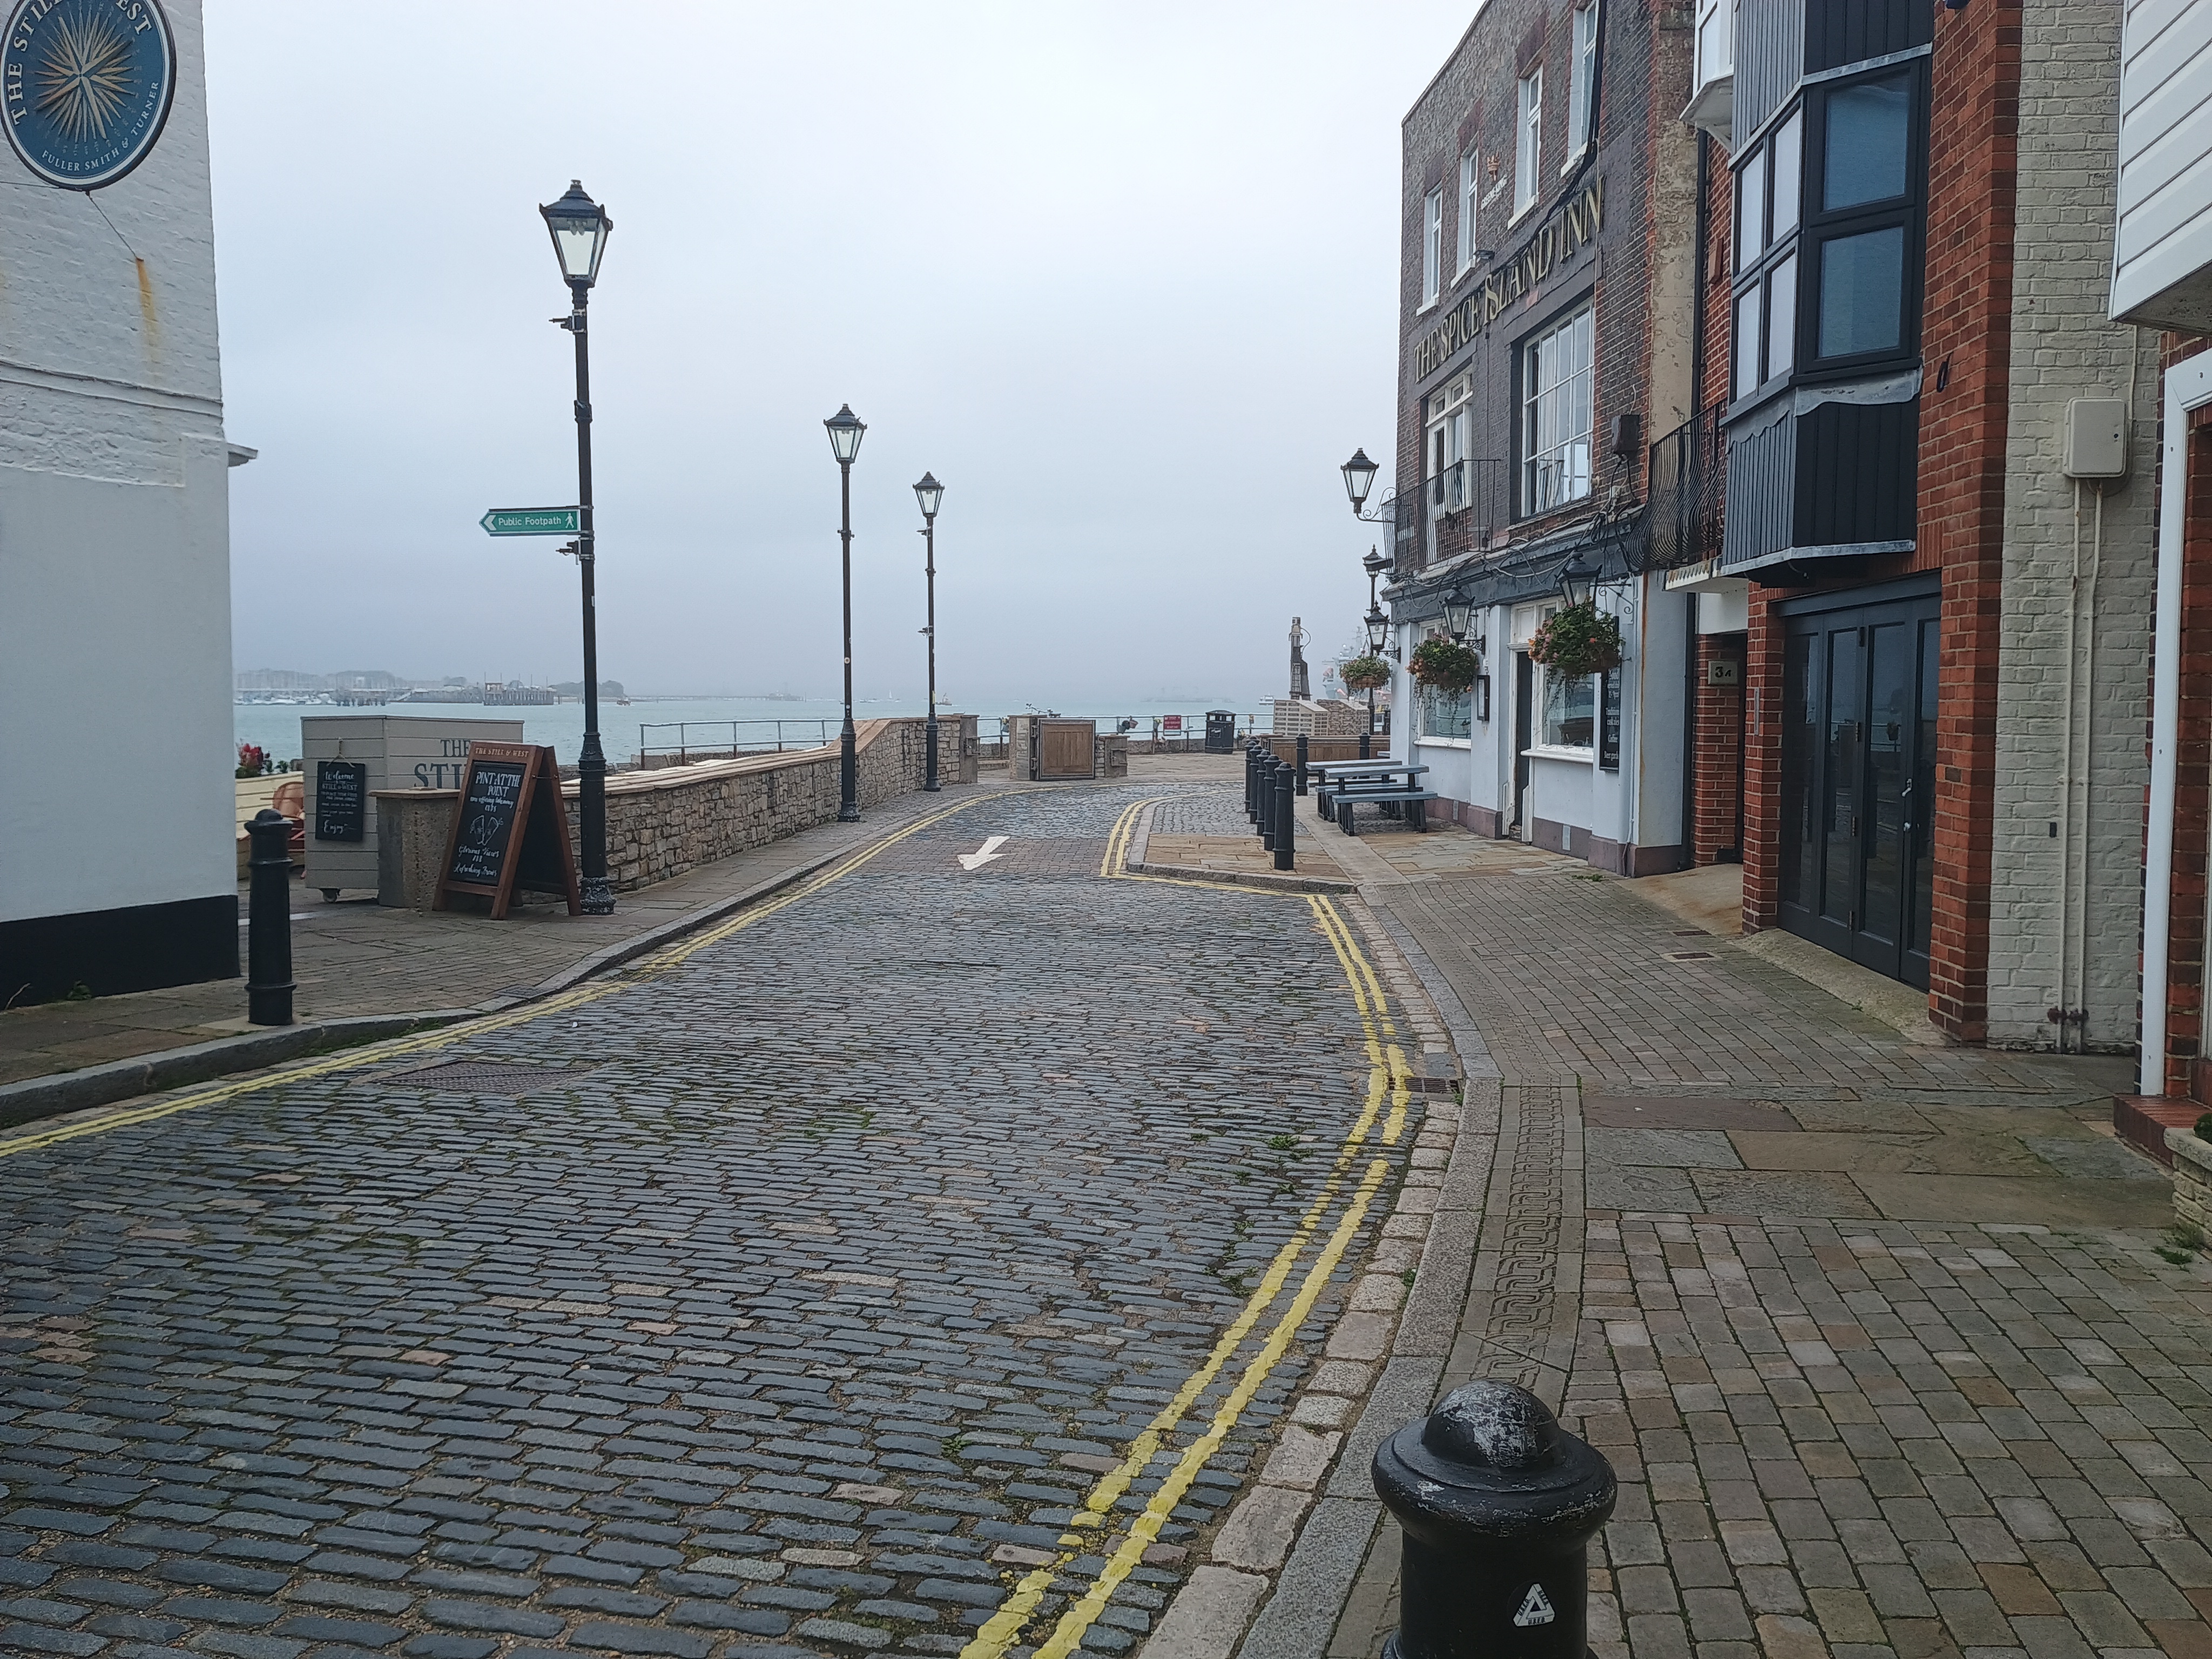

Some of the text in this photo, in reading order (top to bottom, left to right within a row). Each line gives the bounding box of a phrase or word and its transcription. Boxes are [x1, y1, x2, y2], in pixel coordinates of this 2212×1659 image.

[8, 0, 152, 125] THE STIL EST
[42, 82, 159, 171] FULLER SMITH & TURNER
[1414, 174, 1606, 384] THE SPICE ISLAND INN
[498, 516, 561, 526] Public Footpath
[440, 739, 471, 757] THE
[414, 763, 467, 790] STI
[476, 772, 496, 785] PINT
[487, 785, 509, 797] POINT
